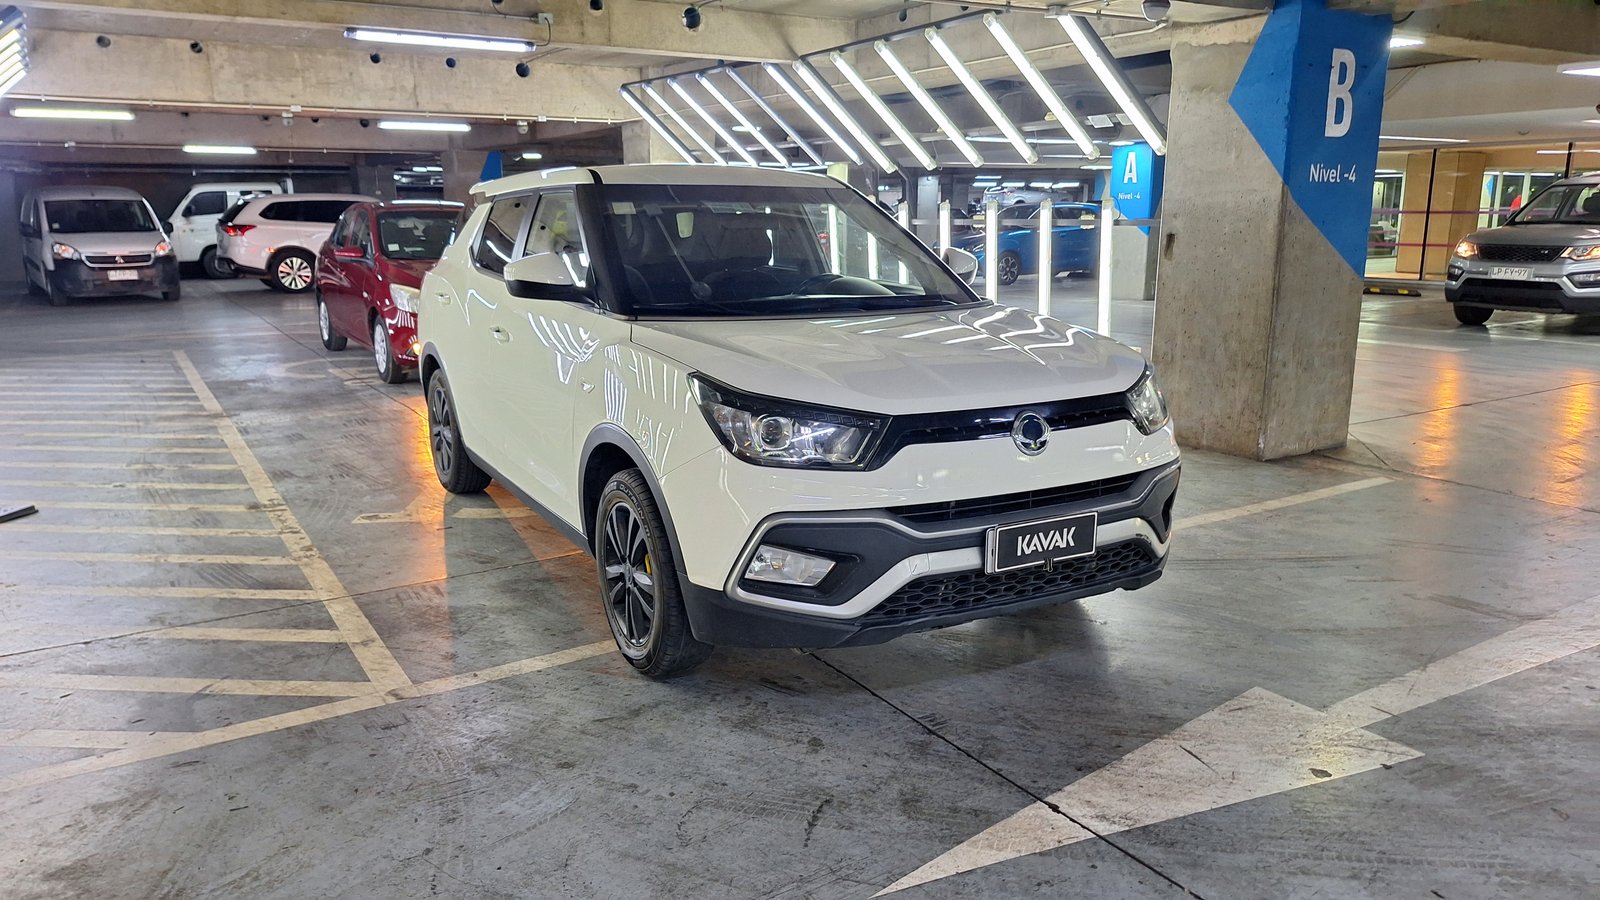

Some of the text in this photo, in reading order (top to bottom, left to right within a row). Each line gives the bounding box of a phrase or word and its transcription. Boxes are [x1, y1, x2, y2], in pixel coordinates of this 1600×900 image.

[1325, 48, 1356, 138] B
[1123, 151, 1138, 184] A
[1309, 163, 1357, 183] Nivel -4
[1118, 192, 1141, 200] Nivel -4
[1016, 526, 1076, 556] KAVAK
